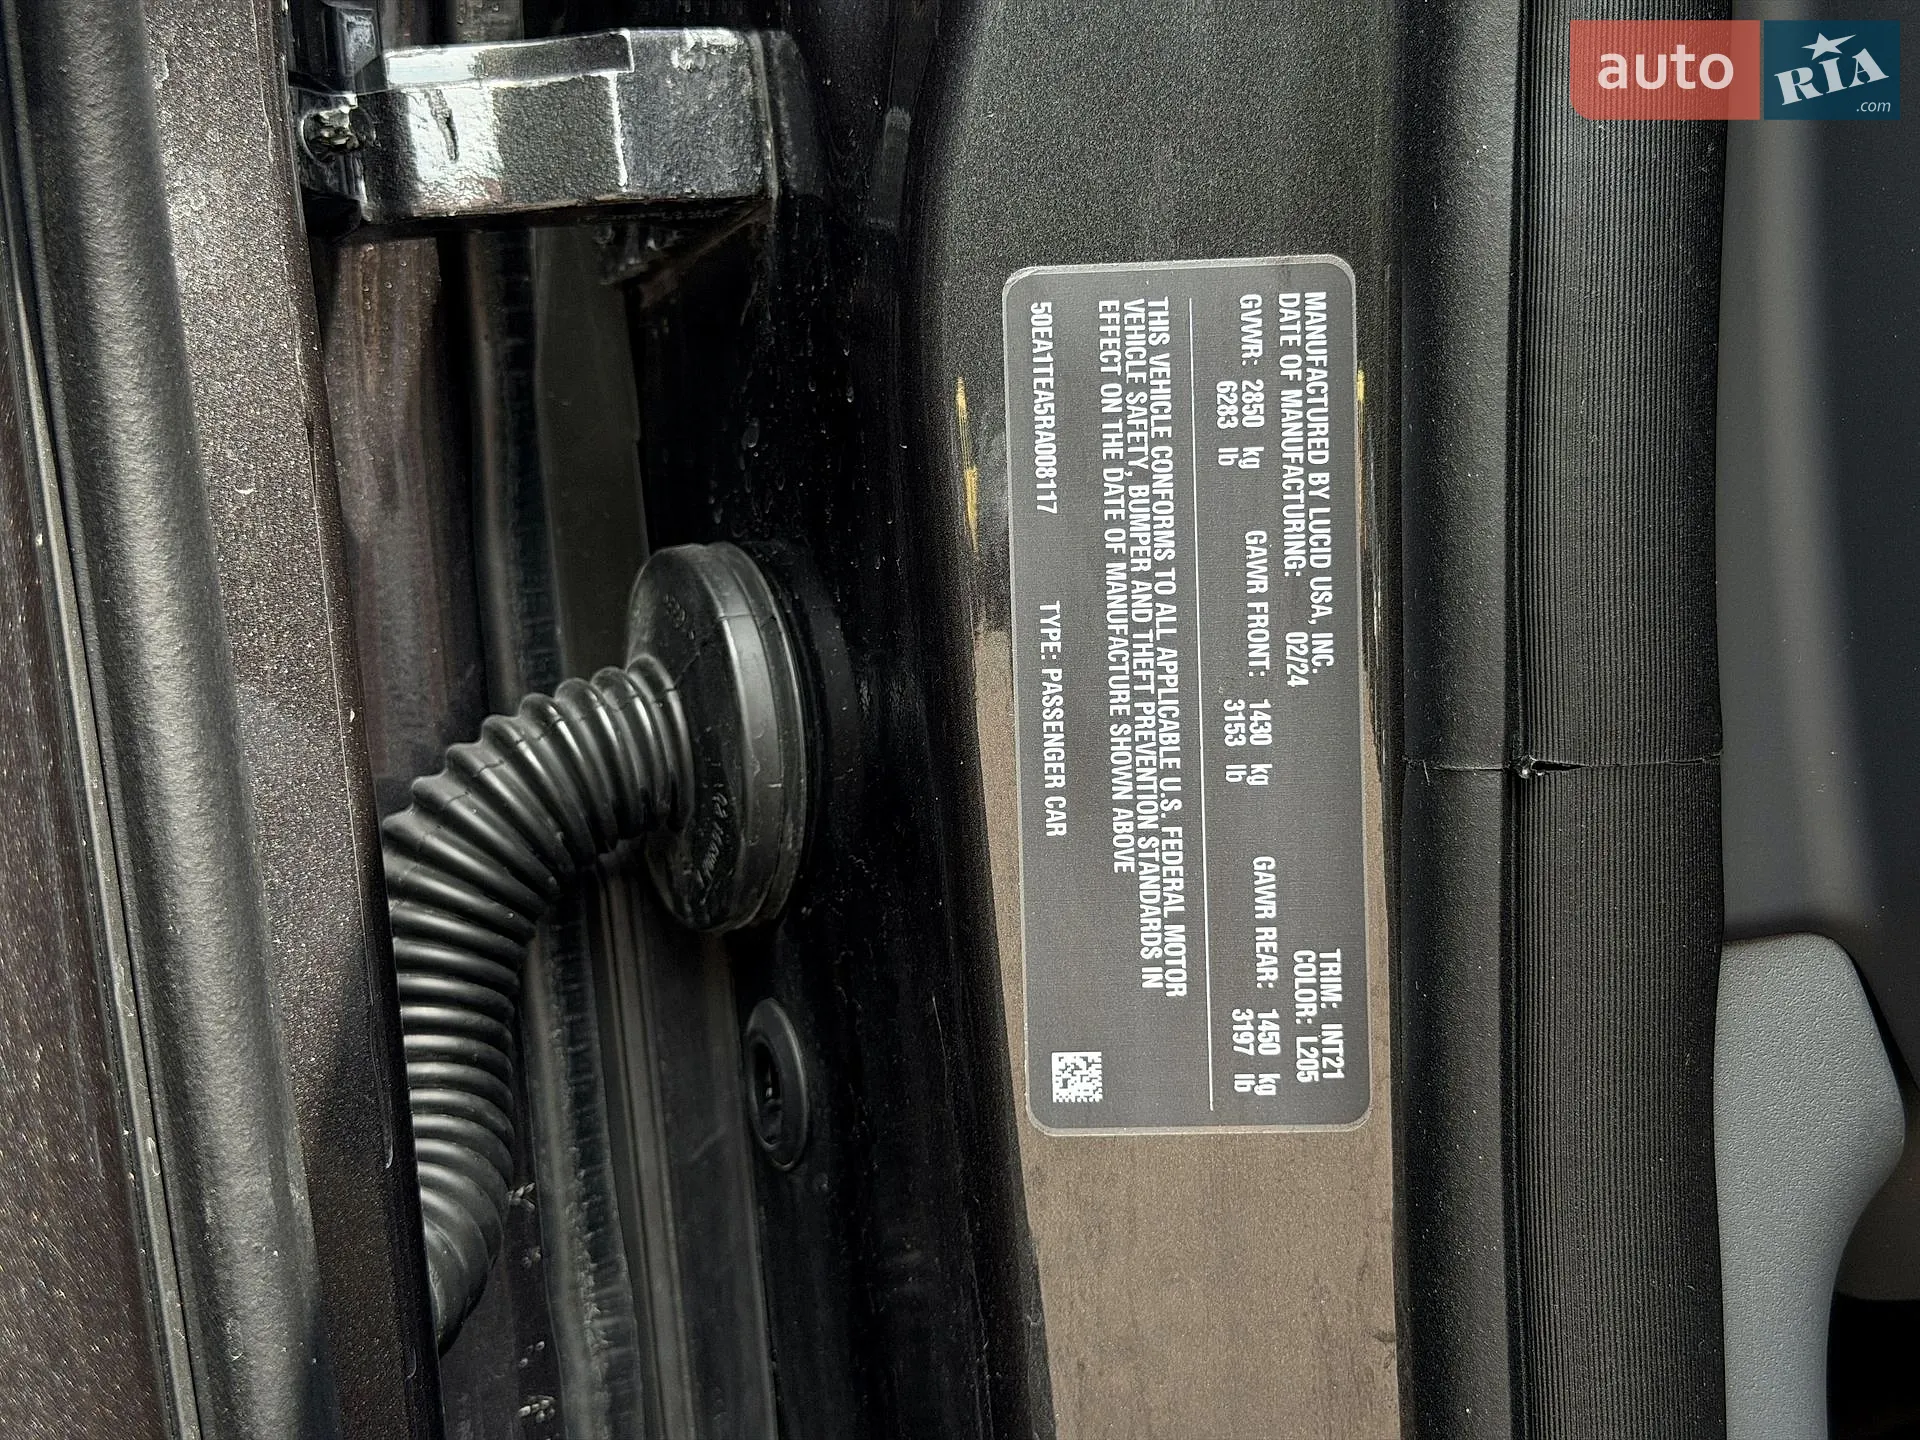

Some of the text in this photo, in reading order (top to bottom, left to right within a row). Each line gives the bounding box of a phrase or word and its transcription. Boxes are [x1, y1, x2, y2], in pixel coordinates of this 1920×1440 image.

[1031, 301, 1058, 514] 50EA1TEA5RA008117
[1216, 381, 1239, 466] 6283 lb
[1238, 294, 1265, 469] GVWR: 2850 kg
[1279, 293, 1309, 687] DATE OF MANUFACTURING: 02/24
[1305, 292, 1334, 673] MANUFACTURED BY LUCID USA, INC.
[1099, 299, 1135, 873] EFFECT ON THE DATE OF MANUFACTURE SHOWN ABOVE
[1124, 297, 1163, 988] VEHICLE SAFETY, BUMPER AND THEFT PREVENTION STANDARDS IN
[1148, 296, 1187, 997] THIS VEHICLE CONFORMS TO ALL APPLICABLE U.S. FEDERAL MOTOR
[1245, 530, 1273, 785] GAWR FRONT: 1430 kg
[1038, 600, 1067, 836] TYPE: PASSENGER CAR
[1224, 699, 1247, 782] 3153 lb
[1232, 1009, 1256, 1092] 3197 lb
[1253, 856, 1281, 1096] GAWR REAR: 1450 kg
[1294, 950, 1320, 1083] COLOR: L205
[1319, 948, 1344, 1078] TRIM: INT21
